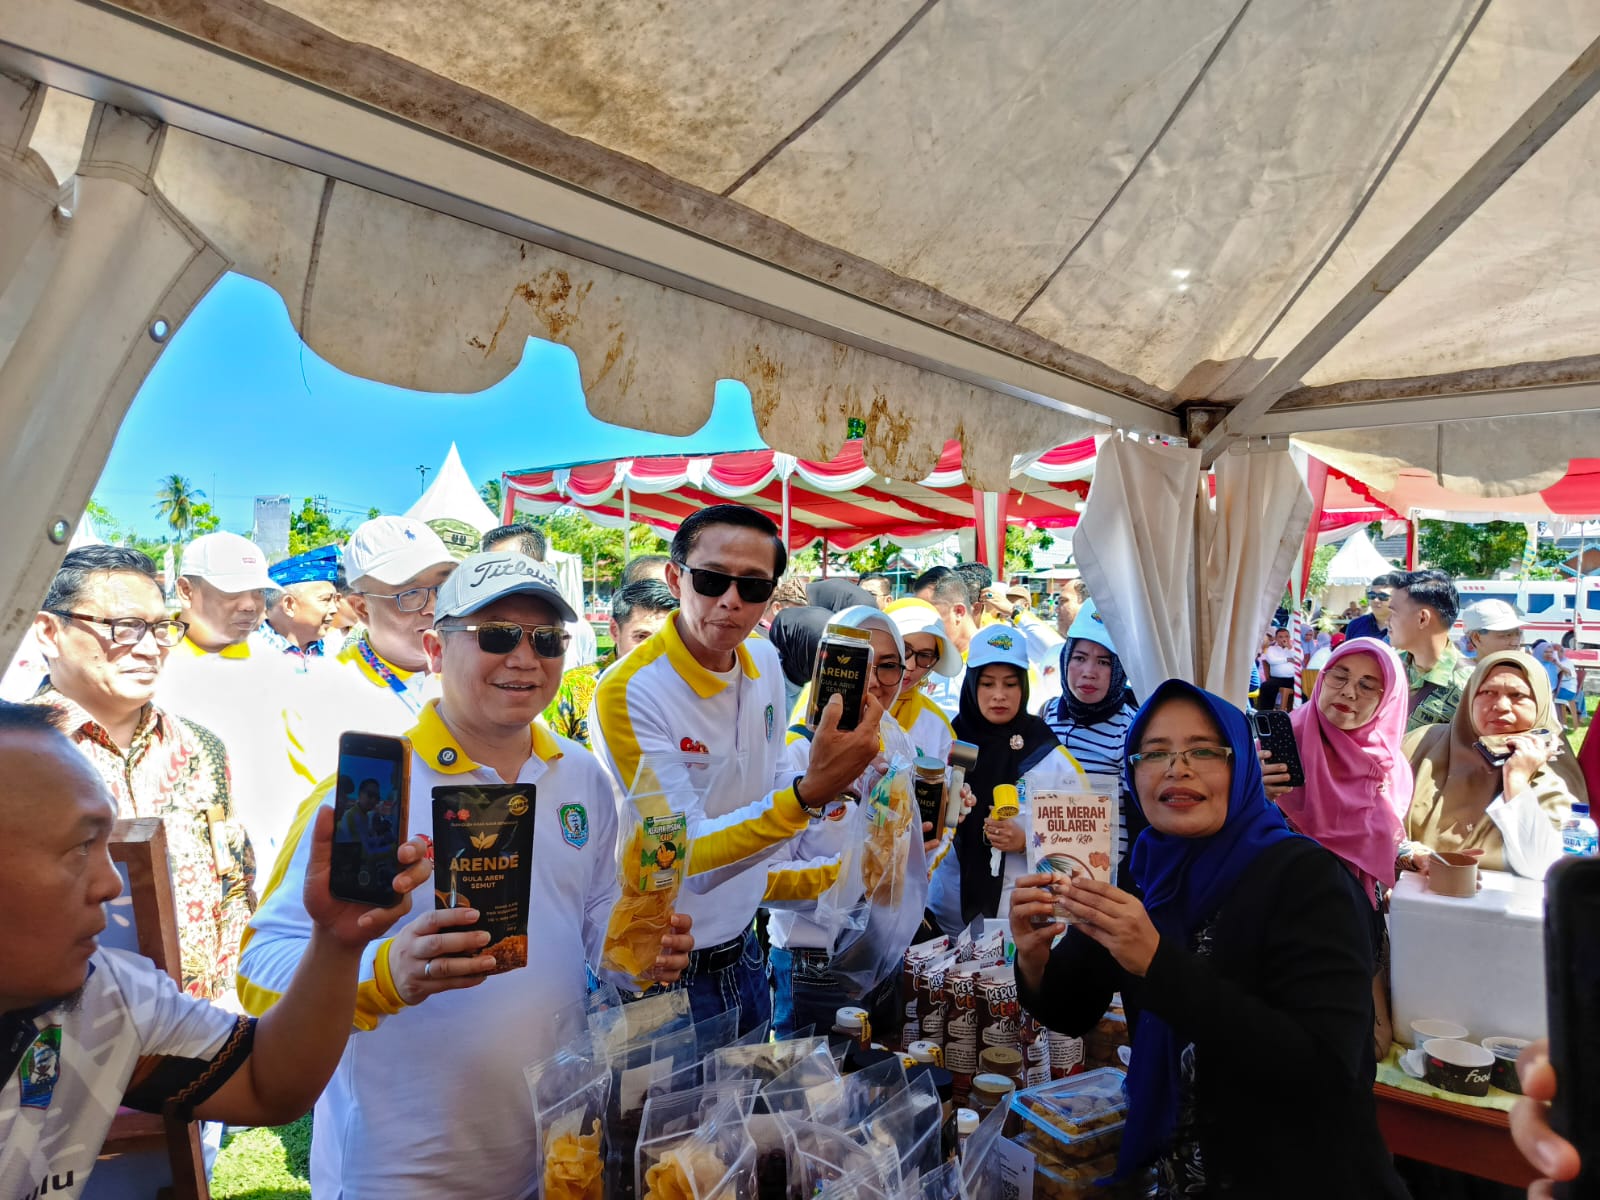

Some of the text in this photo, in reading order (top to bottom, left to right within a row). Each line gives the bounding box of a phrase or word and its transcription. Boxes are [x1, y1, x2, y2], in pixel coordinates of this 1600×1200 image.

[1037, 806, 1106, 820] JAHE MERAH
[1047, 819, 1097, 832] GULAREN
